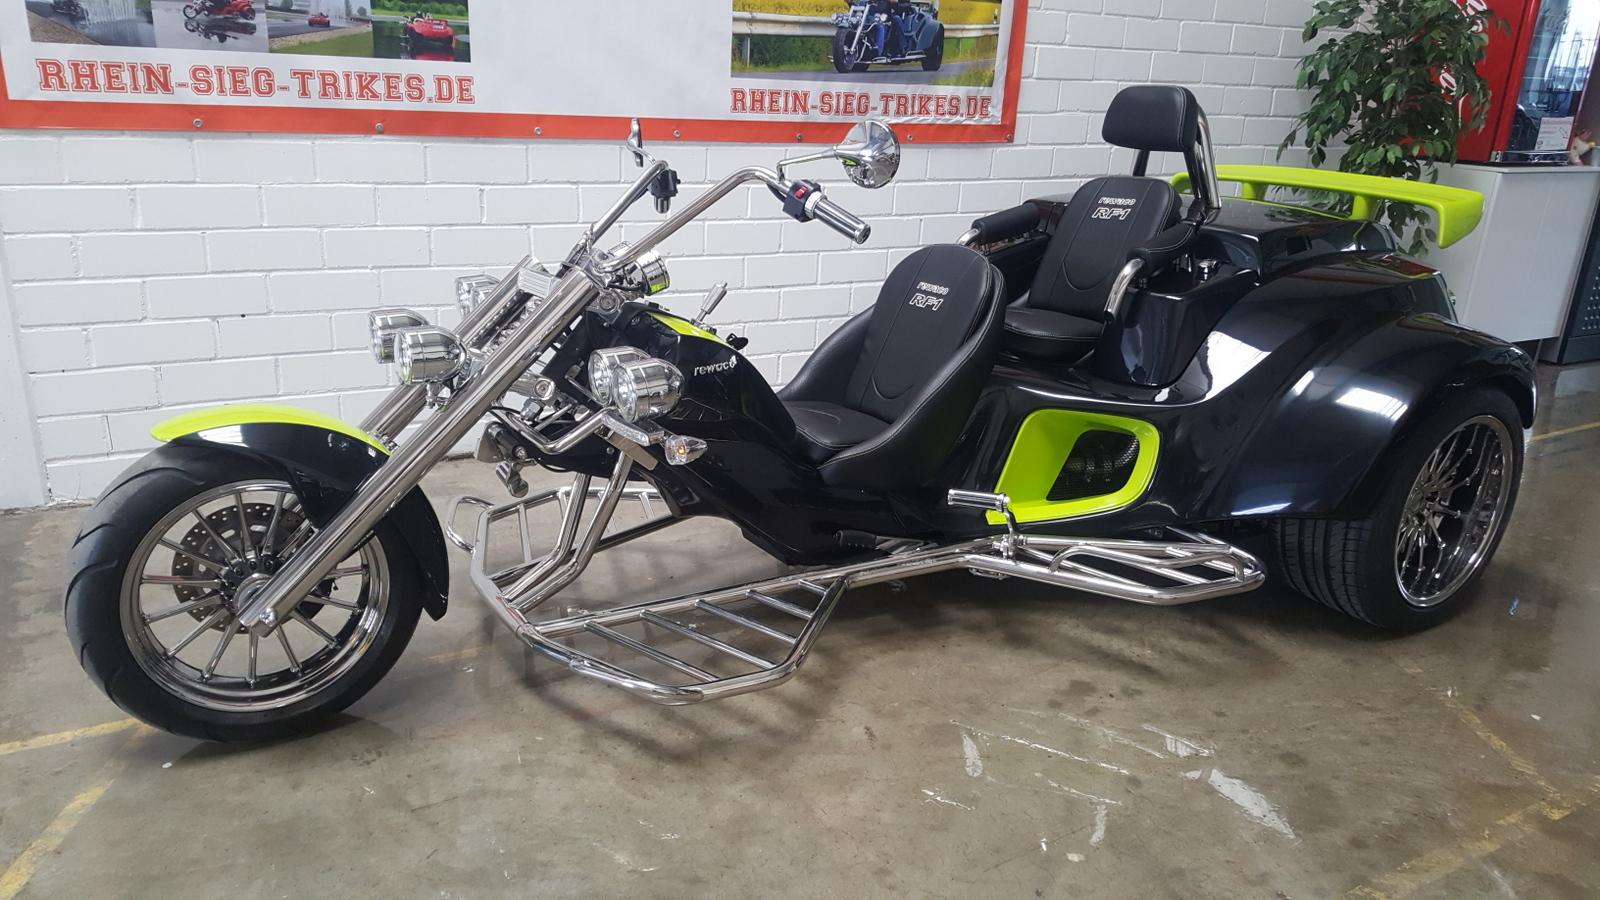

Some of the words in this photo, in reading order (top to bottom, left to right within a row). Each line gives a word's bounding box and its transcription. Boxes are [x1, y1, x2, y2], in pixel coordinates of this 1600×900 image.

[35, 58, 475, 104] RHEIN-SIEG-TRIKES.DE
[730, 87, 992, 118] RHEIN-SIEG-TRIKES.DE
[1091, 206, 1132, 221] RF1
[908, 292, 944, 311] RF1
[693, 357, 738, 377] rewaco
